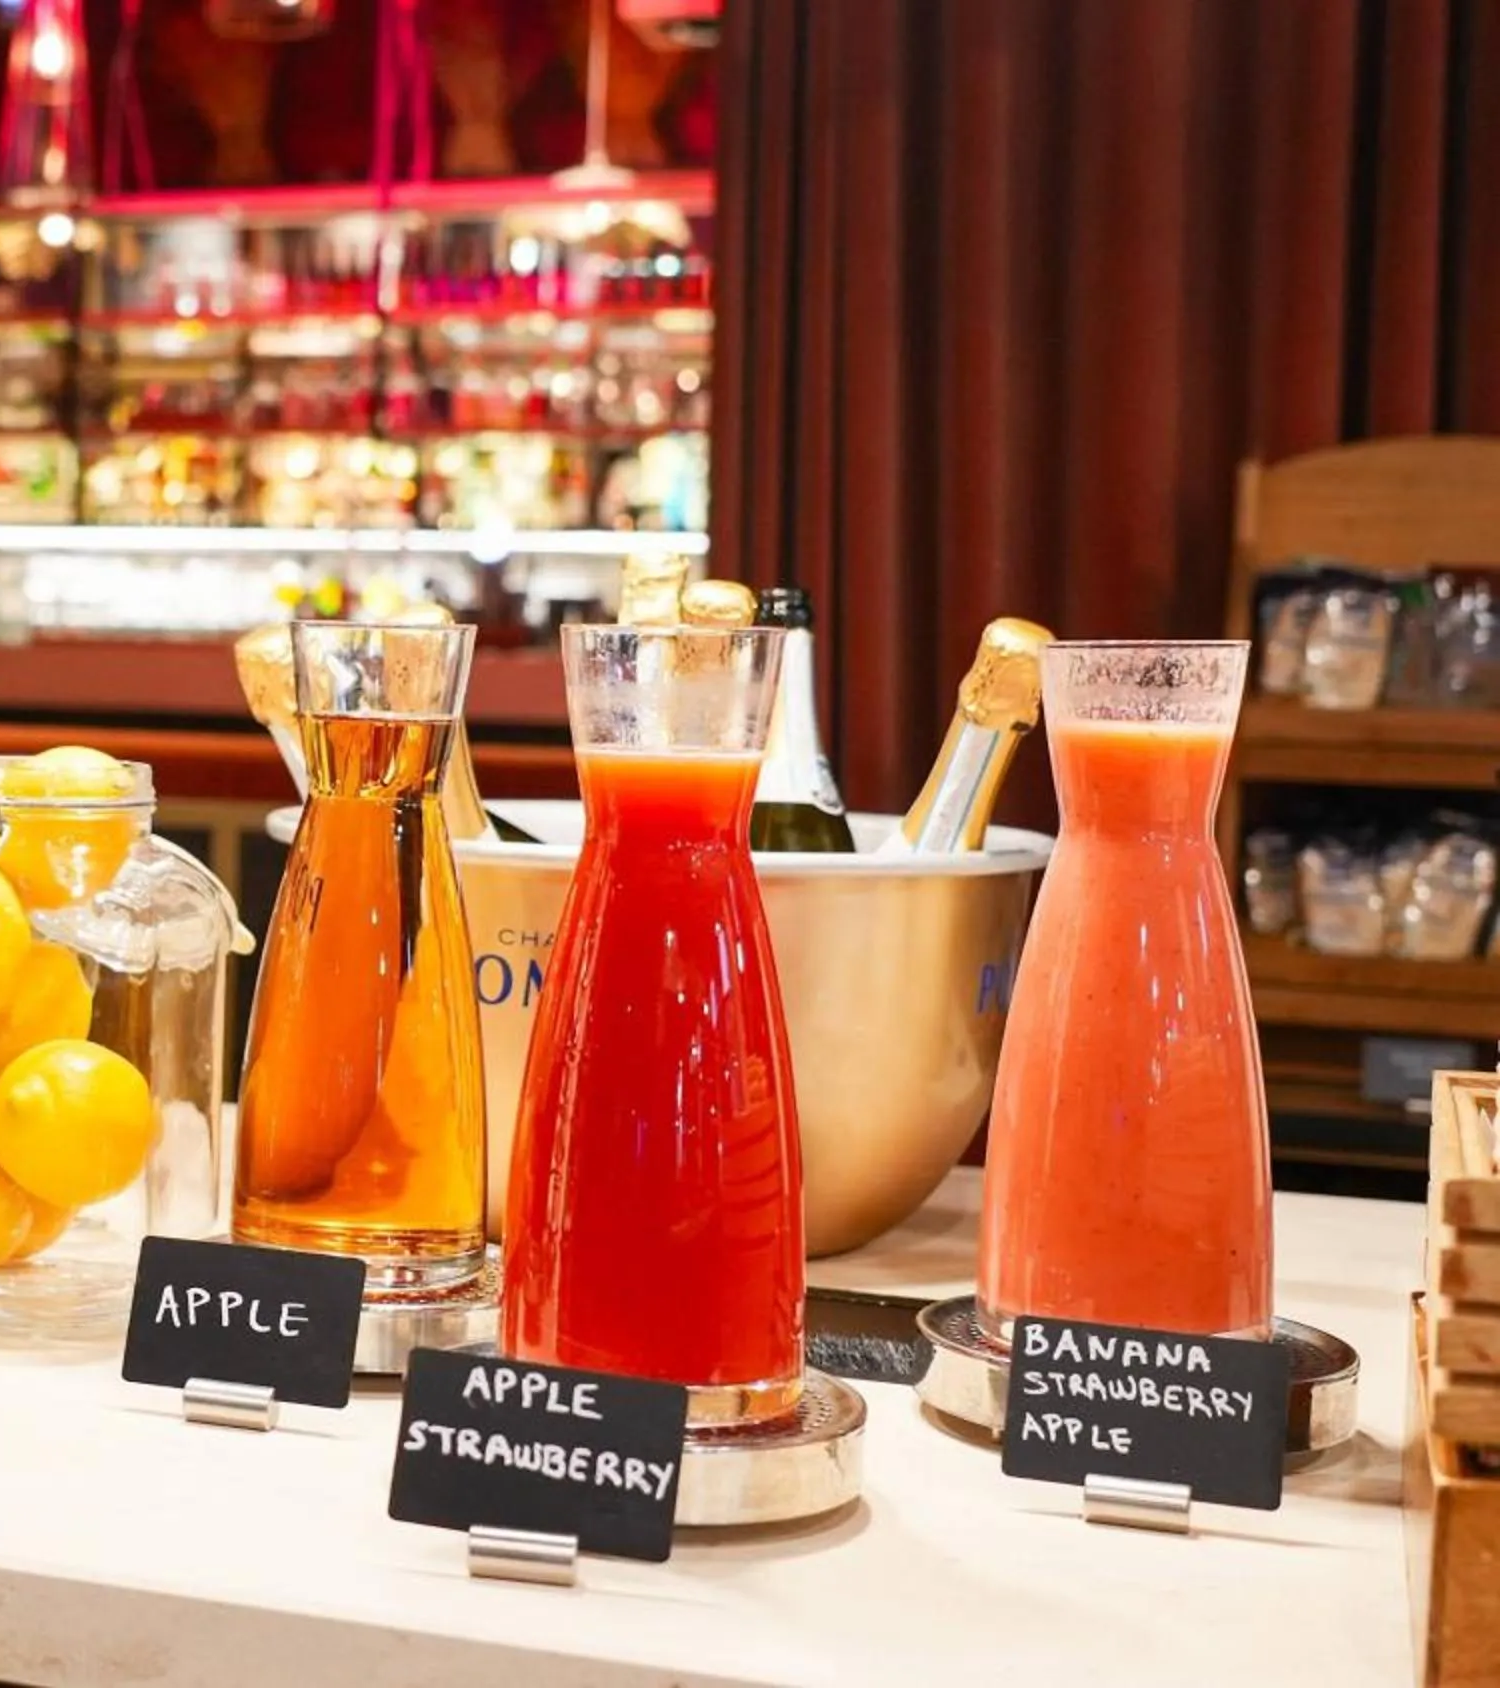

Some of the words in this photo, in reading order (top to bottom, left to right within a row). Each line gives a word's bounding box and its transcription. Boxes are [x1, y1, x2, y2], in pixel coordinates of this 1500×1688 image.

[155, 1284, 309, 1337] APPLE
[1023, 1323, 1212, 1373] BANANA
[462, 1365, 603, 1420] APPLE
[1023, 1371, 1253, 1422] STRAWBERRY
[1021, 1411, 1132, 1454] APPLE
[403, 1419, 674, 1500] STRAWBERRY
